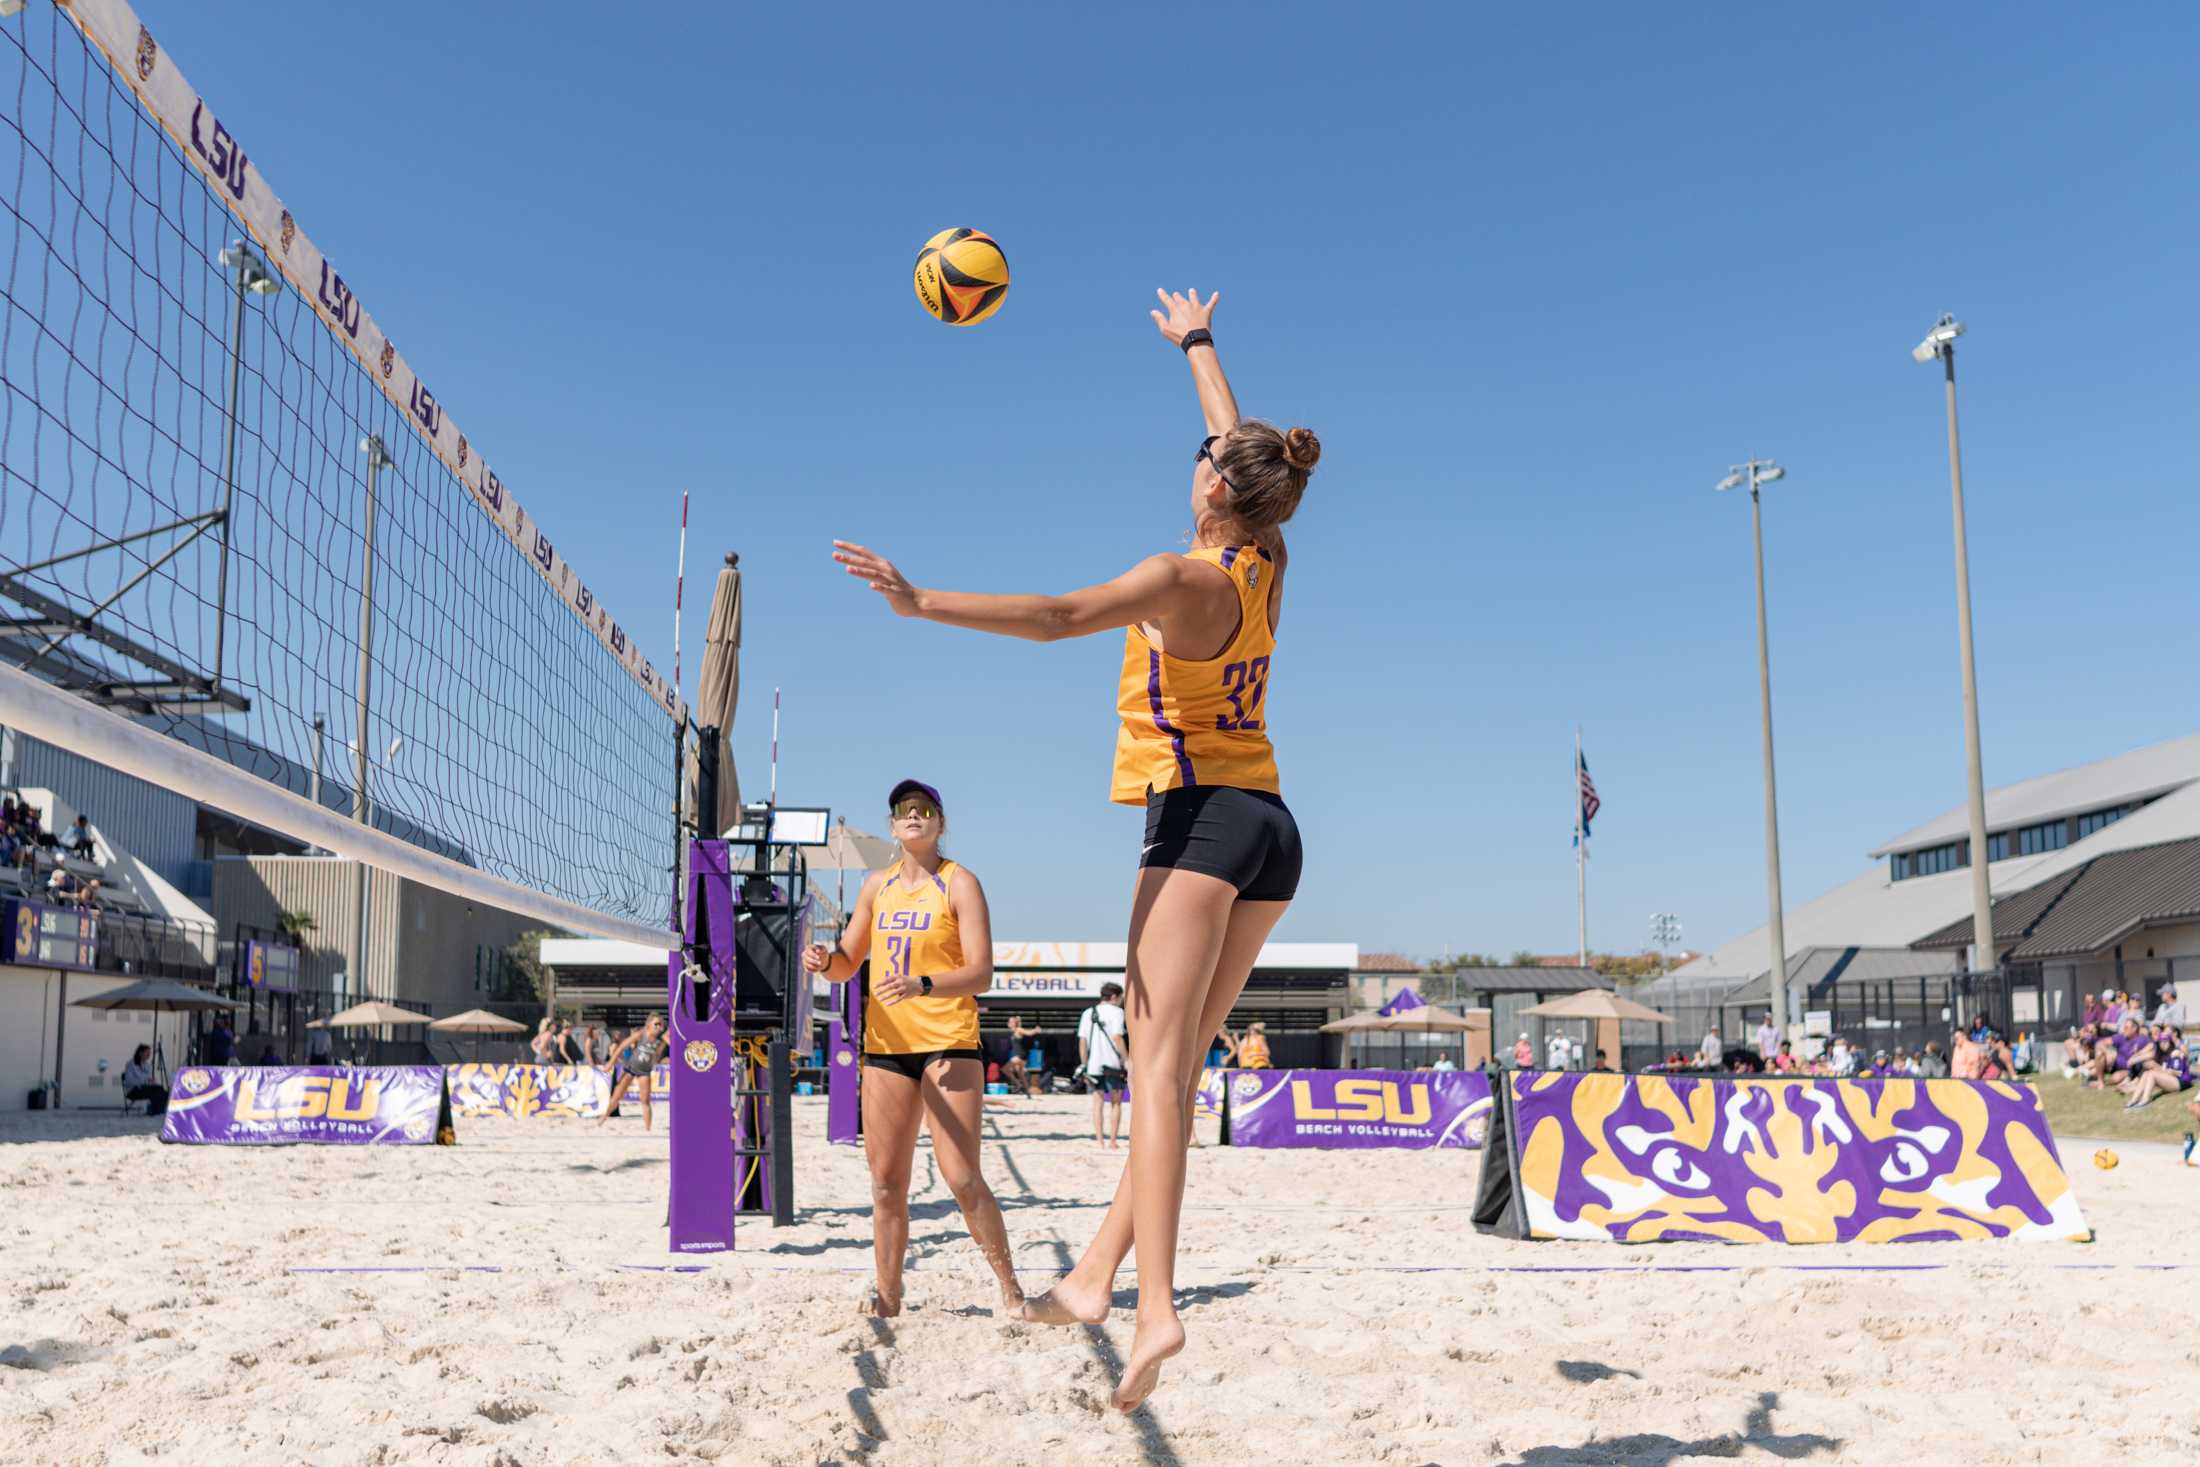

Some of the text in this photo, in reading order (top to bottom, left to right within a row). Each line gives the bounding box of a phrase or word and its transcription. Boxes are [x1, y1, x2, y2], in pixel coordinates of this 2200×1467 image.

[191, 96, 247, 200] LSU
[319, 258, 360, 338] LSU
[411, 375, 441, 437] LSU
[480, 459, 503, 513] LSU
[533, 527, 553, 571] LSU
[576, 579, 593, 616] LSU
[1215, 655, 1270, 730] 32
[16, 906, 33, 957] 3
[878, 911, 931, 931] LSU
[252, 945, 263, 985] 5
[885, 936, 912, 977] 31
[993, 977, 1086, 991] LEYBALL
[233, 1076, 382, 1121] LSU
[1291, 1079, 1432, 1125] LSU
[283, 1121, 374, 1134] VOLLEYBALL
[1296, 1124, 1434, 1138] BEACH VOLLEYBALL
